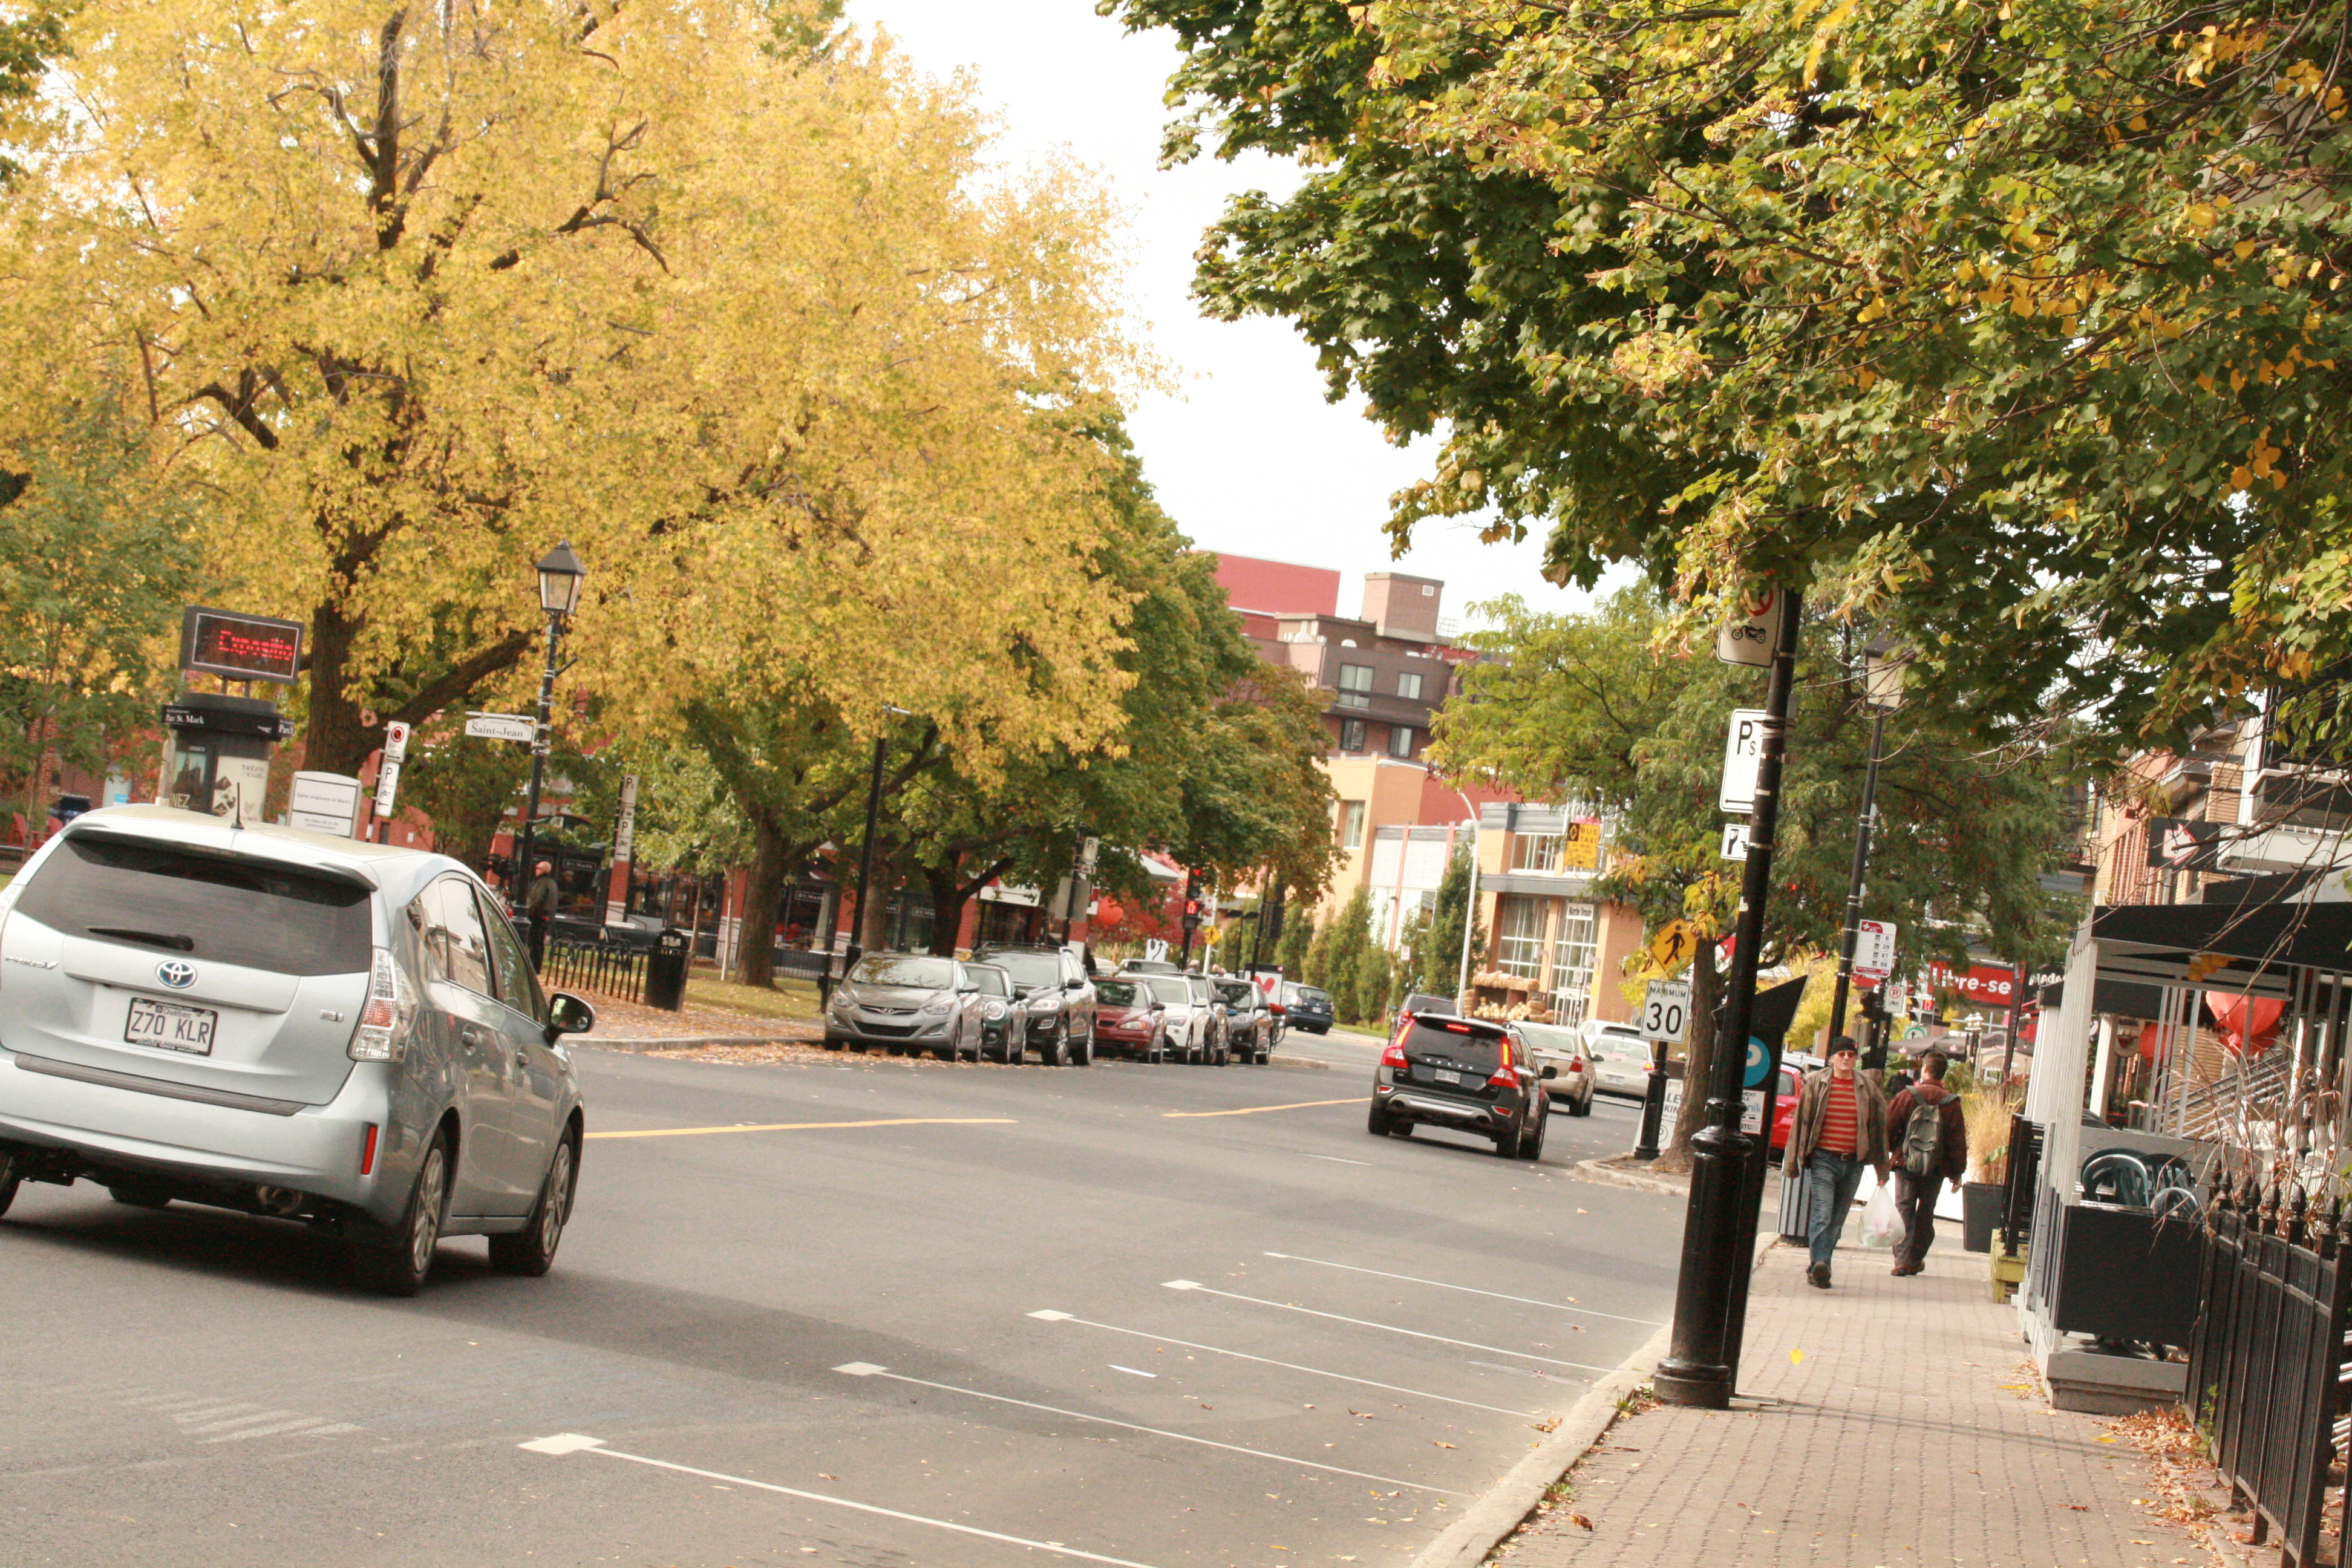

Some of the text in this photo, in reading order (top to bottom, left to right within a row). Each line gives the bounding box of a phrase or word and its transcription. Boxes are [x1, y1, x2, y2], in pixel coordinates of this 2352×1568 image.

[185, 714, 205, 725] Mark
[471, 724, 523, 737] Saint-Jean
[385, 766, 393, 780] P
[163, 1007, 192, 1019] Québec
[1645, 1002, 1682, 1035] 30
[131, 1010, 211, 1044] Z70 KLR
[1426, 1058, 1474, 1071] VOLVO
